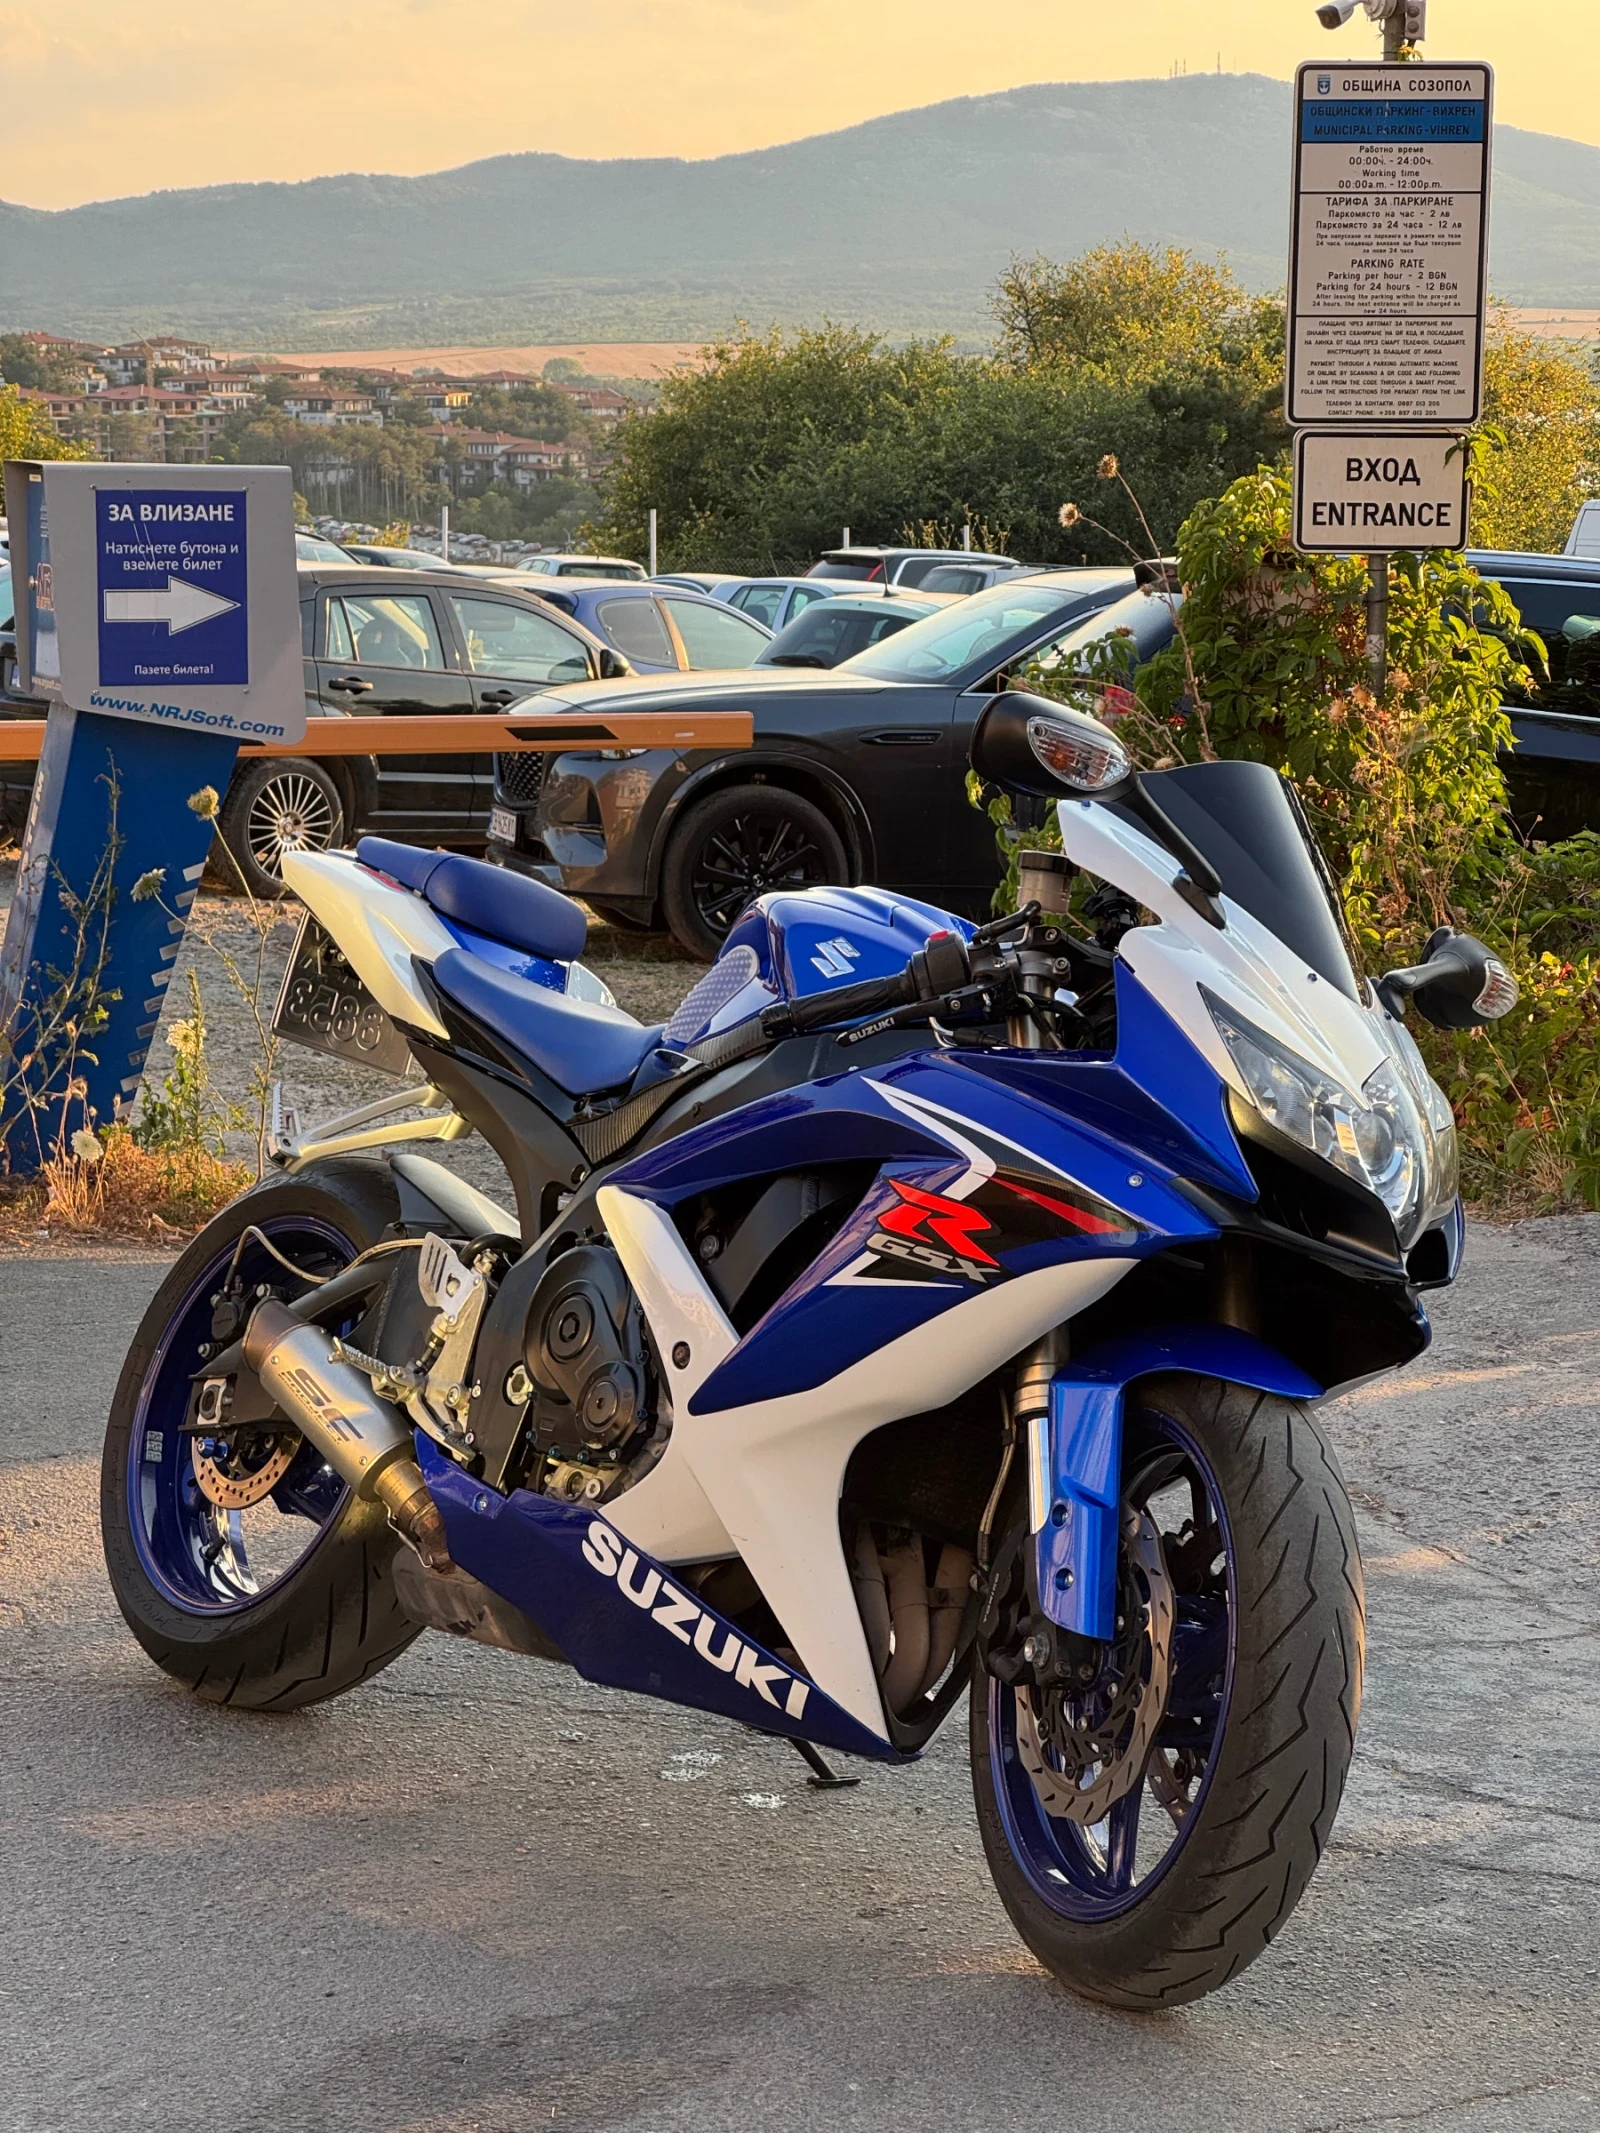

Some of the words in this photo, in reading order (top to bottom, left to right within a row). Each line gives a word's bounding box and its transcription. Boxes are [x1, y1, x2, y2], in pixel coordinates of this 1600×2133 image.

[1343, 80, 1401, 93] ОБЩИНА
[1409, 80, 1471, 92] СОЗОПОЛ
[1310, 106, 1372, 118] ОБЩИНСКИ
[1314, 125, 1372, 135] MUNICIPAL
[1359, 146, 1393, 154] Работно
[1398, 147, 1424, 155] време
[1362, 169, 1396, 179] Working
[1401, 169, 1420, 177] time
[1326, 197, 1368, 206] ТАРИФА
[1374, 197, 1387, 206] ЗА
[1393, 197, 1454, 206] ПАРКИРАНЕ
[1328, 209, 1380, 220] Паркомясто
[1430, 209, 1436, 218] 2
[1316, 220, 1368, 231] Паркомясто
[1387, 220, 1398, 229] 24
[1439, 220, 1448, 229] 12
[1351, 259, 1394, 268] PARKING
[1400, 259, 1424, 268] RATE
[1328, 271, 1360, 281] Parking
[1365, 273, 1379, 281] per
[1383, 272, 1403, 280] hour
[1418, 271, 1424, 280] 2
[1428, 271, 1446, 280] BGN
[1316, 282, 1349, 293] Parking
[1353, 282, 1365, 291] for
[1370, 282, 1381, 291] 24
[1386, 282, 1411, 291] hours
[1426, 282, 1435, 291] 12
[1439, 282, 1457, 291] BGN
[1346, 458, 1421, 486] ВХОД
[108, 504, 134, 521] ЗА
[140, 504, 234, 521] ВЛИЗАНЕ
[1312, 502, 1451, 527] ENTRANCE
[105, 541, 176, 555] Натиснете
[180, 540, 226, 557] бутона
[230, 543, 239, 554] и
[123, 560, 179, 571] вземете
[182, 557, 222, 571] билет
[134, 664, 171, 675] Пазете
[173, 663, 214, 675] билета!
[90, 694, 285, 737] www.NRJSoft.com
[848, 1017, 895, 1043] SUZUKI
[865, 1232, 1001, 1284] GSX
[582, 1521, 810, 1720] SUZUKI
